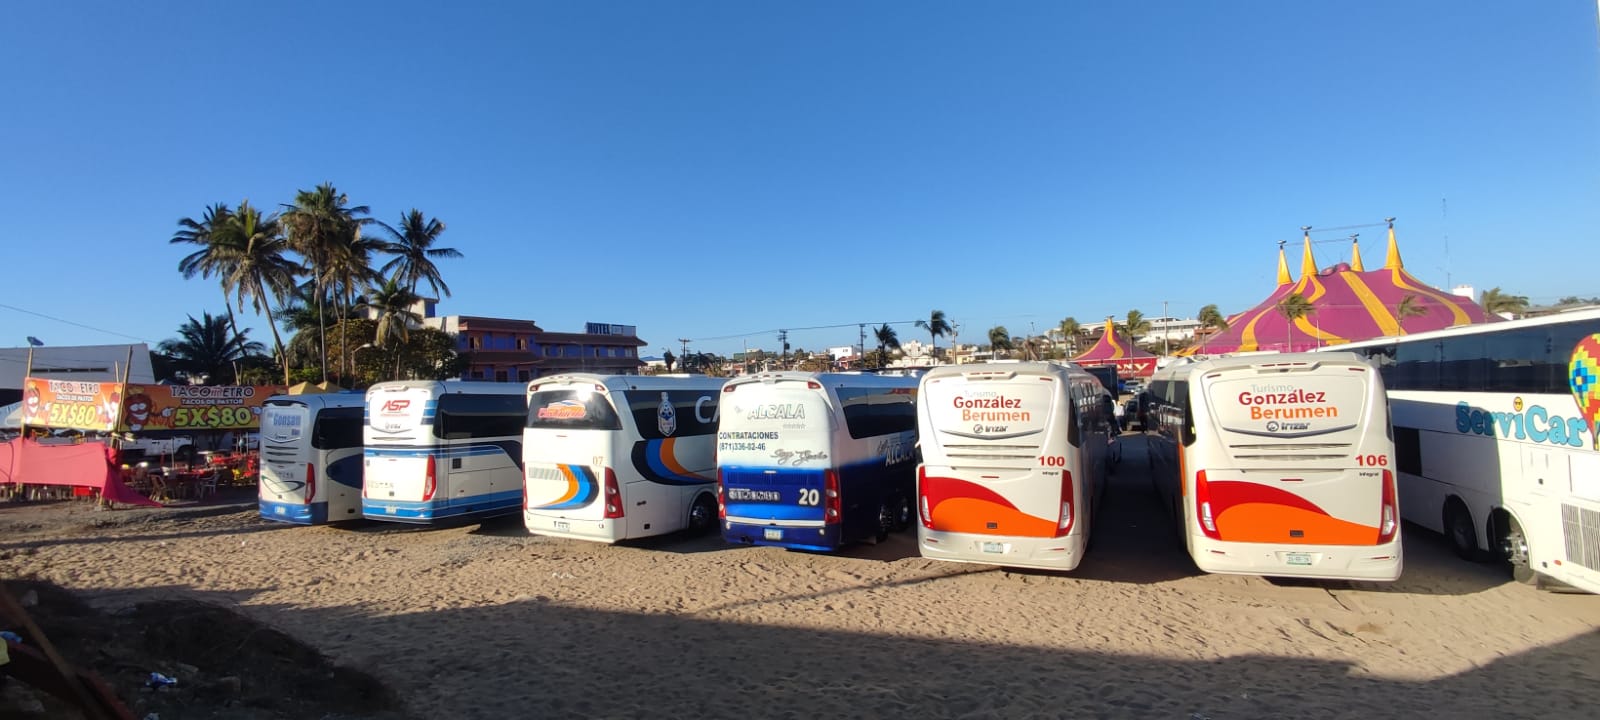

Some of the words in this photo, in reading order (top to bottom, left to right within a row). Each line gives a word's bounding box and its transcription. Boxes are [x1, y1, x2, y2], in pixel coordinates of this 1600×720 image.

[586, 322, 610, 335] HOTEL
[953, 396, 1021, 409] González
[1238, 389, 1326, 405] González
[381, 400, 410, 411] ASP
[747, 404, 806, 420] ALCALA
[175, 406, 251, 427] 5X$80
[962, 409, 1031, 422] Berumen
[1251, 407, 1337, 420] Berumen
[1456, 397, 1588, 447] ServiCar
[719, 431, 778, 439] CONTRATACIONES
[1038, 456, 1065, 467] 100
[1355, 455, 1387, 466] 106
[798, 488, 819, 506] 20
